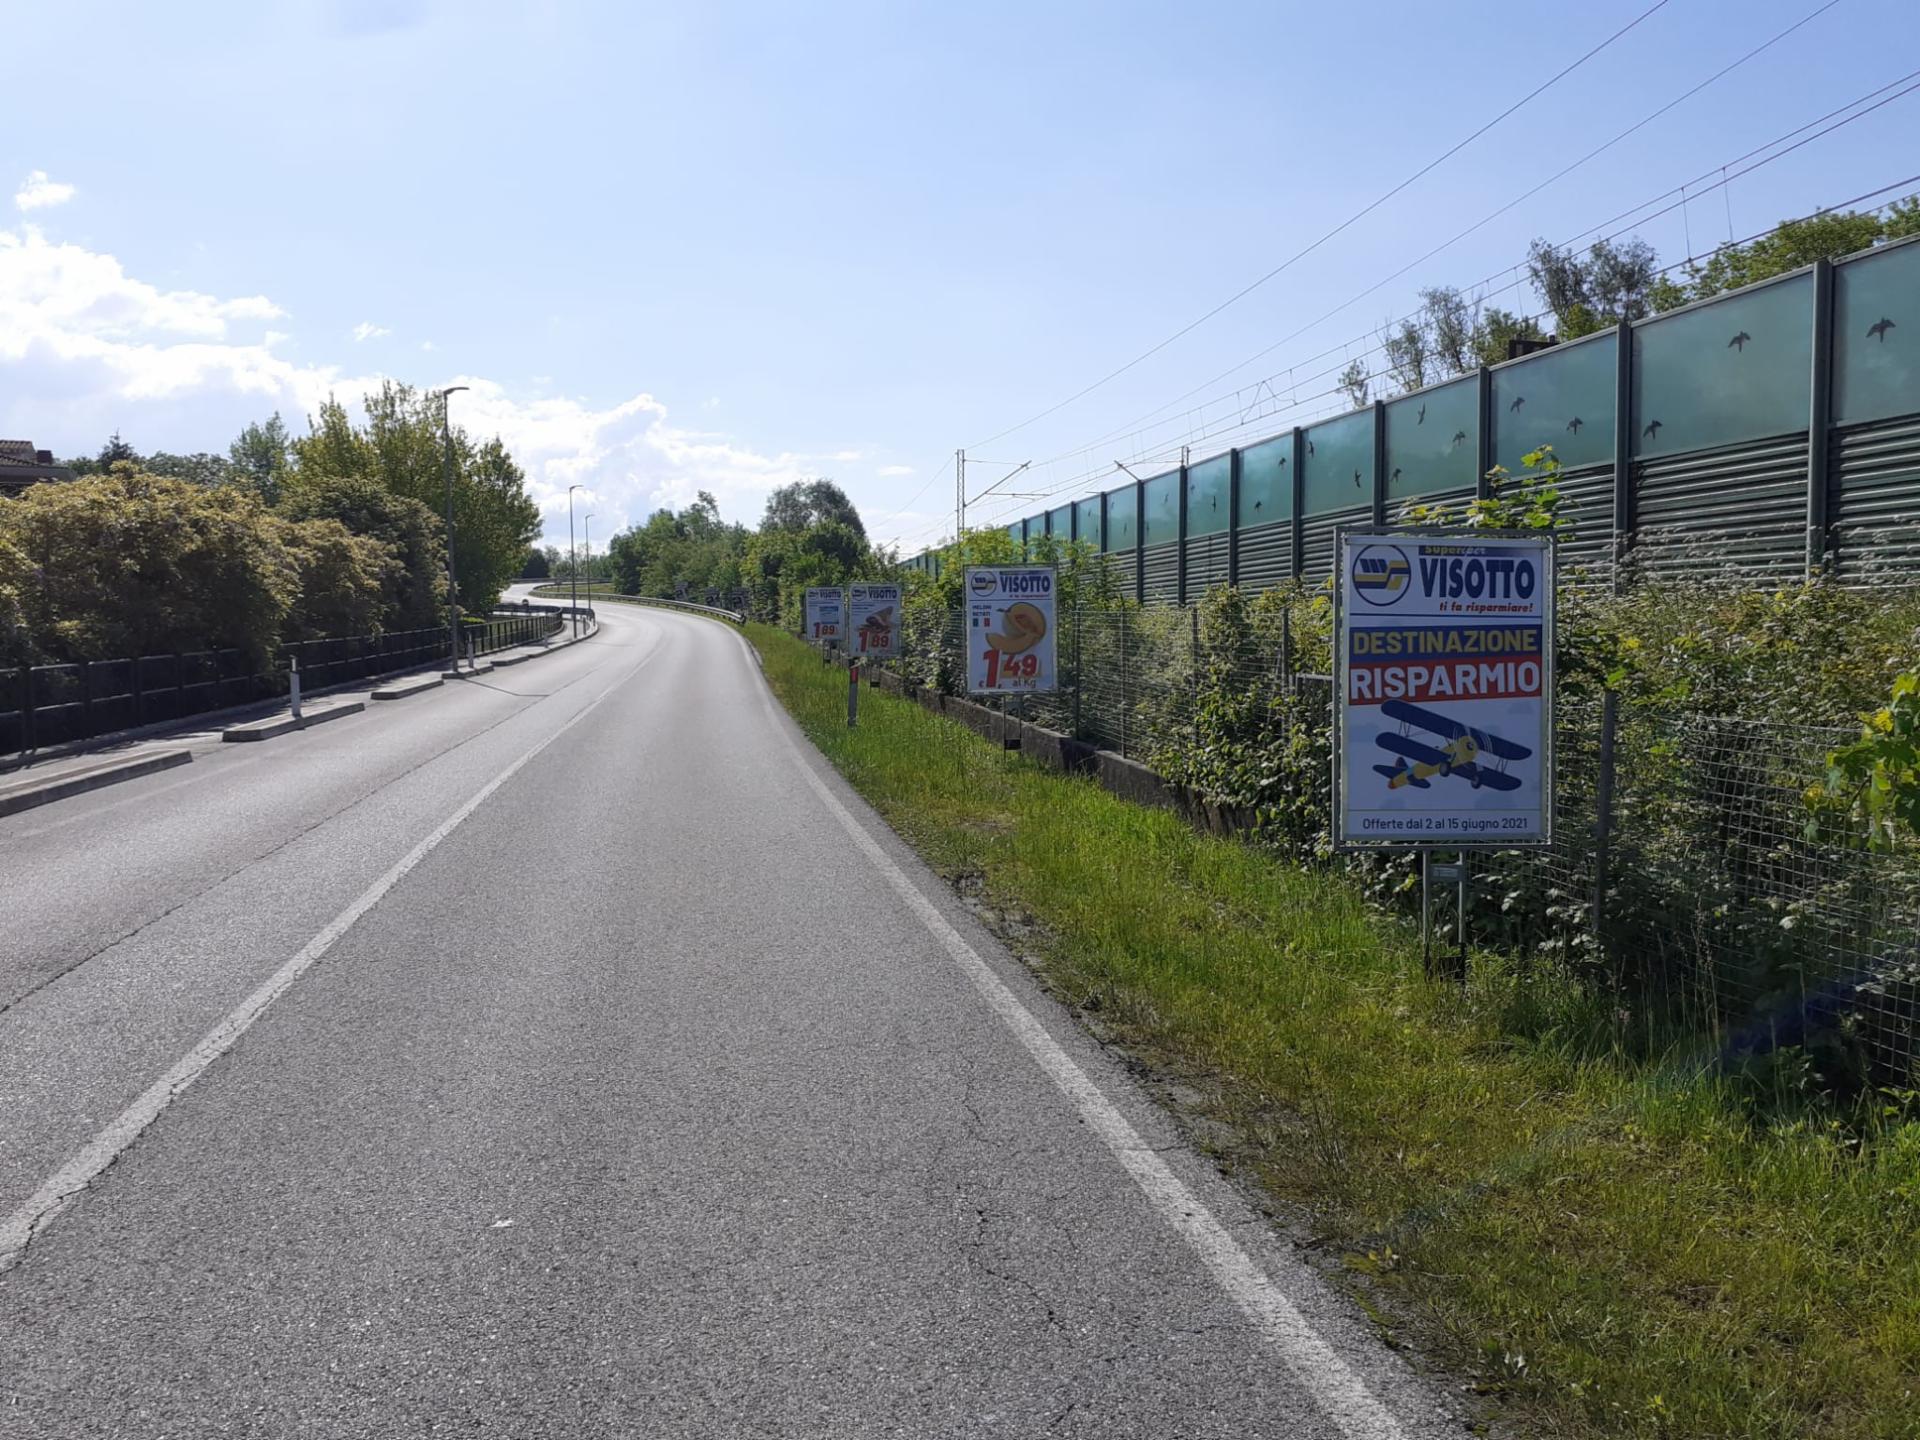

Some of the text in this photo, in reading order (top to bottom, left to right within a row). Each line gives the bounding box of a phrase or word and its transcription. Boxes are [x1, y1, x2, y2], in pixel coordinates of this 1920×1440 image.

[1000, 576, 1050, 592] VISOTTO
[1419, 558, 1535, 600] VISOTTO
[868, 589, 898, 599] VISOTTO
[1440, 601, 1534, 613] ti fa risparmiare!
[1353, 629, 1538, 655] DESTINAZIONE
[1350, 661, 1540, 700] RISPARMIO
[1362, 818, 1528, 832] Offerte dal 2 al 15 giugno 2021
